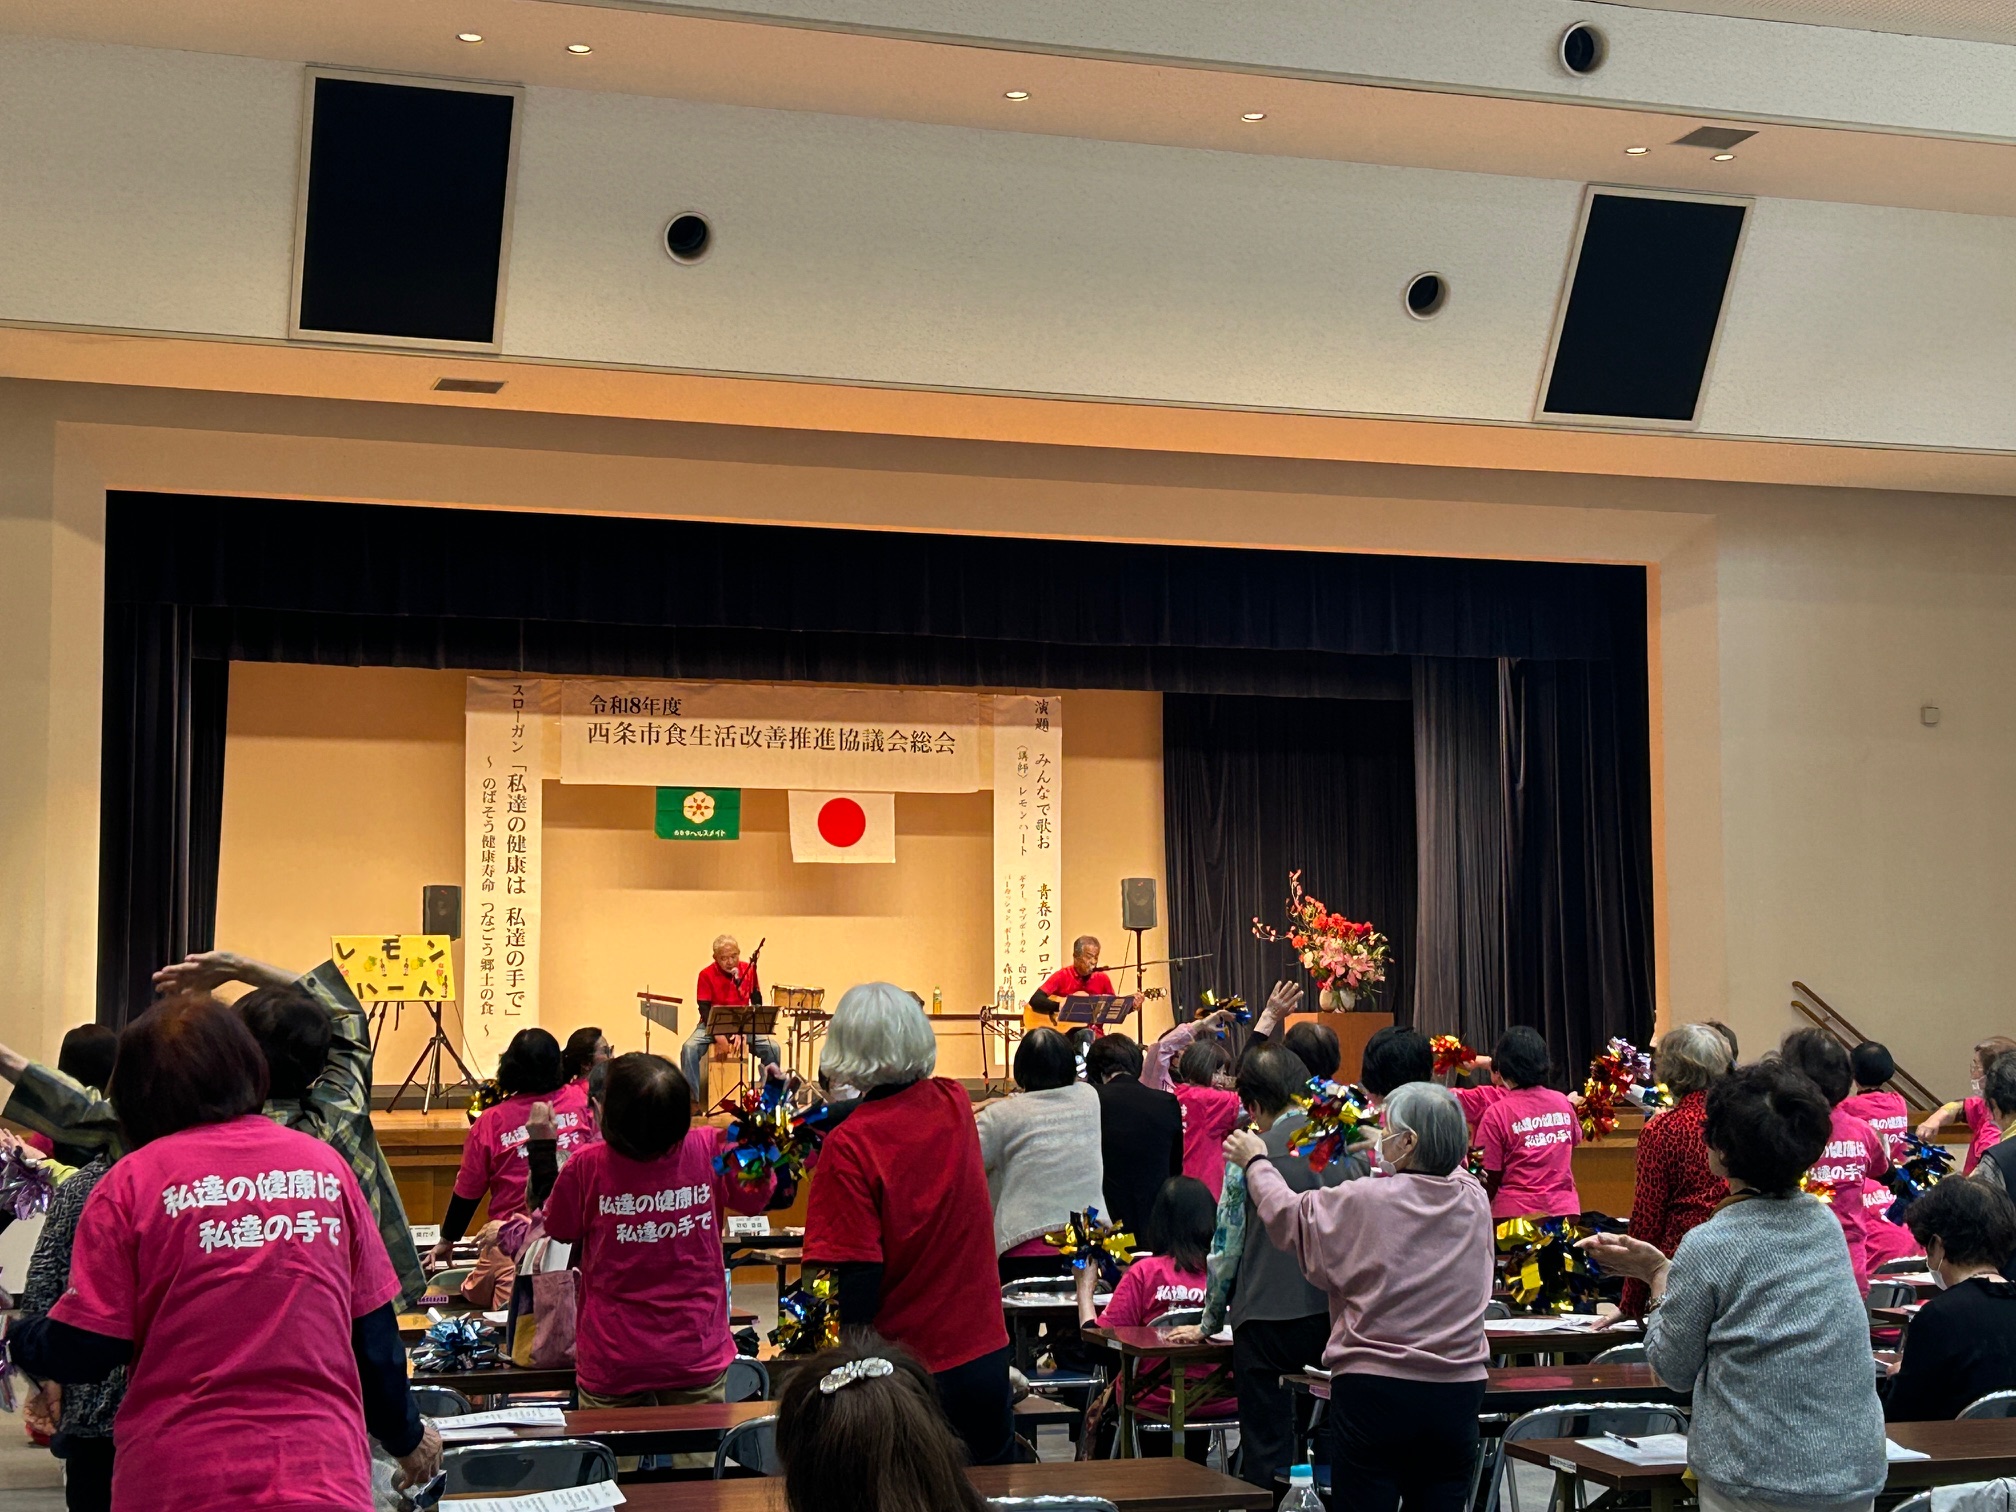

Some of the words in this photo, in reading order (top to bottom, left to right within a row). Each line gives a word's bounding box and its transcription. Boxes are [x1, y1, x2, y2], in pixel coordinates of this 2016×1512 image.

[512, 684, 525, 753] スローガン
[589, 694, 682, 717] 令和8年度
[1035, 699, 1049, 733] 演題
[587, 720, 956, 755] 西条市食生活改善推進協議会総会
[481, 777, 497, 893] のばそう健康寿命
[1019, 786, 1029, 856] レモンハート
[336, 938, 445, 963] レモン
[480, 902, 495, 1015] つなごう郷土の食
[162, 1169, 341, 1218] 私達の健康は
[599, 1183, 711, 1216] 私達の健康は
[199, 1210, 341, 1254] 私達の手で
[617, 1211, 712, 1244] 私達の手で
